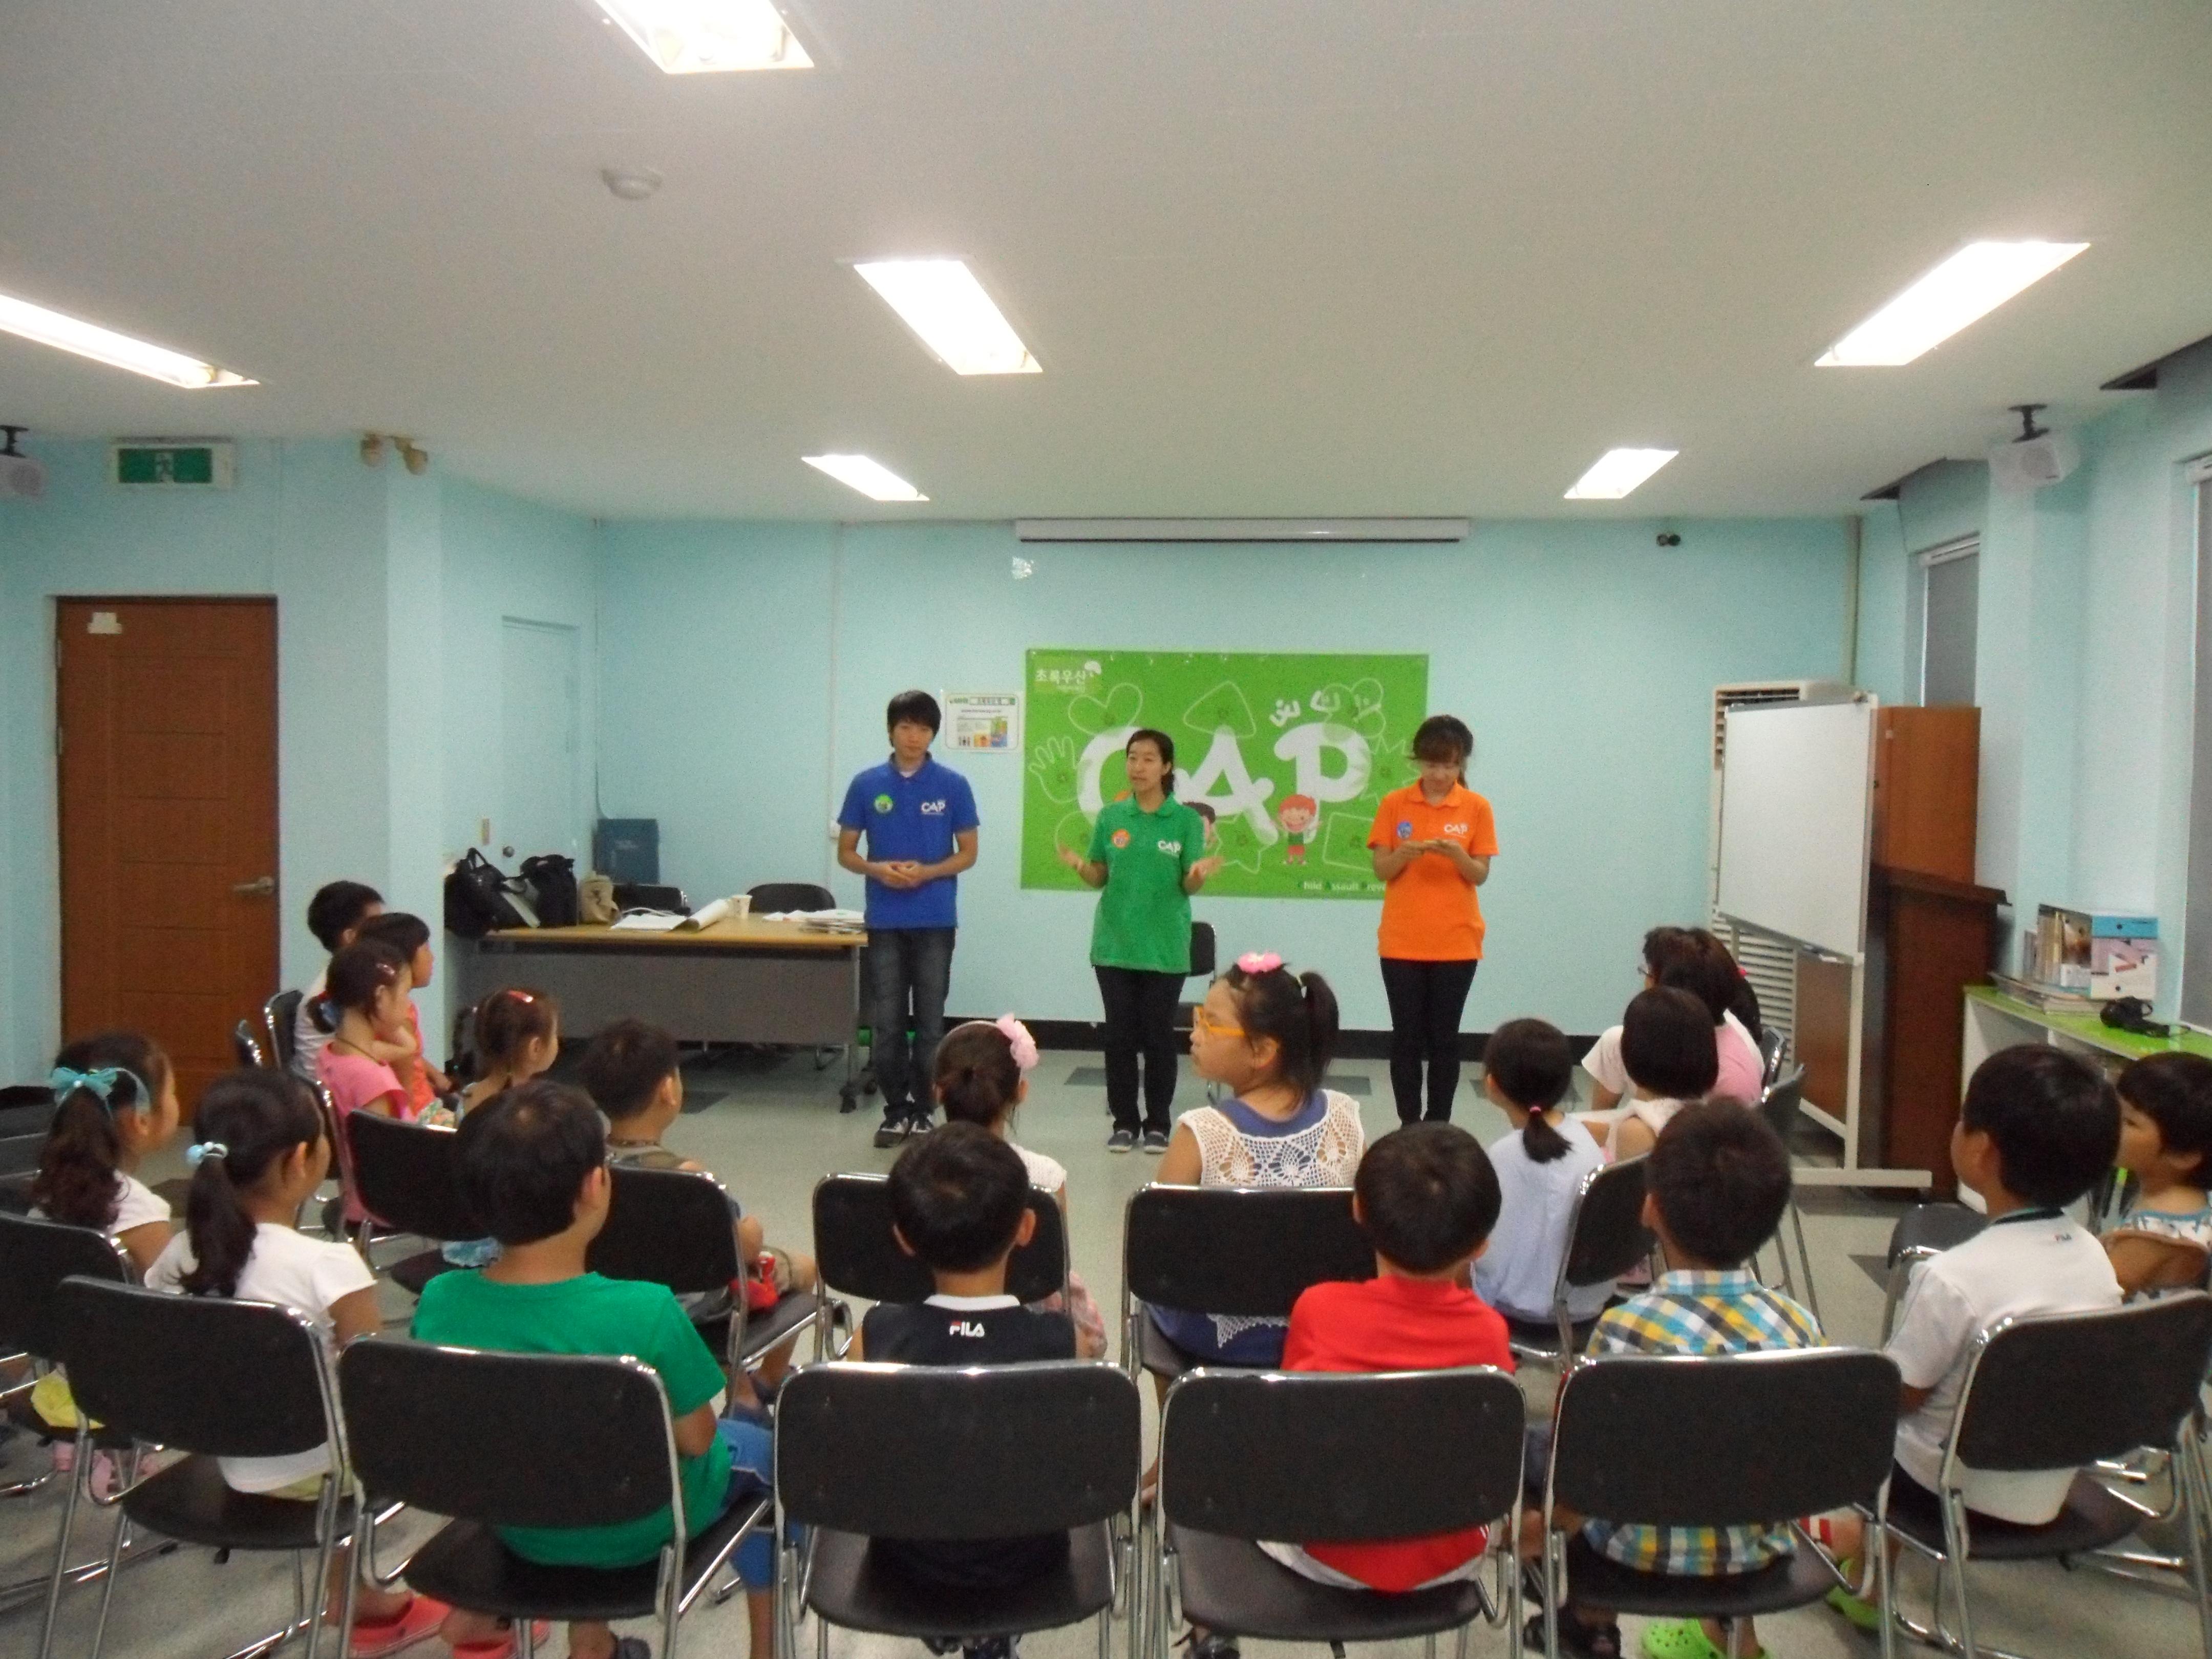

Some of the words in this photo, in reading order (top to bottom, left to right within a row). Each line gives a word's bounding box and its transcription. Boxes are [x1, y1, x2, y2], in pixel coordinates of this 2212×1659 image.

[1076, 722, 1372, 845] CAP
[921, 800, 946, 812] CAP
[1444, 823, 1469, 835] CAP
[1157, 840, 1182, 854] CAP
[949, 1321, 985, 1338] FILA
